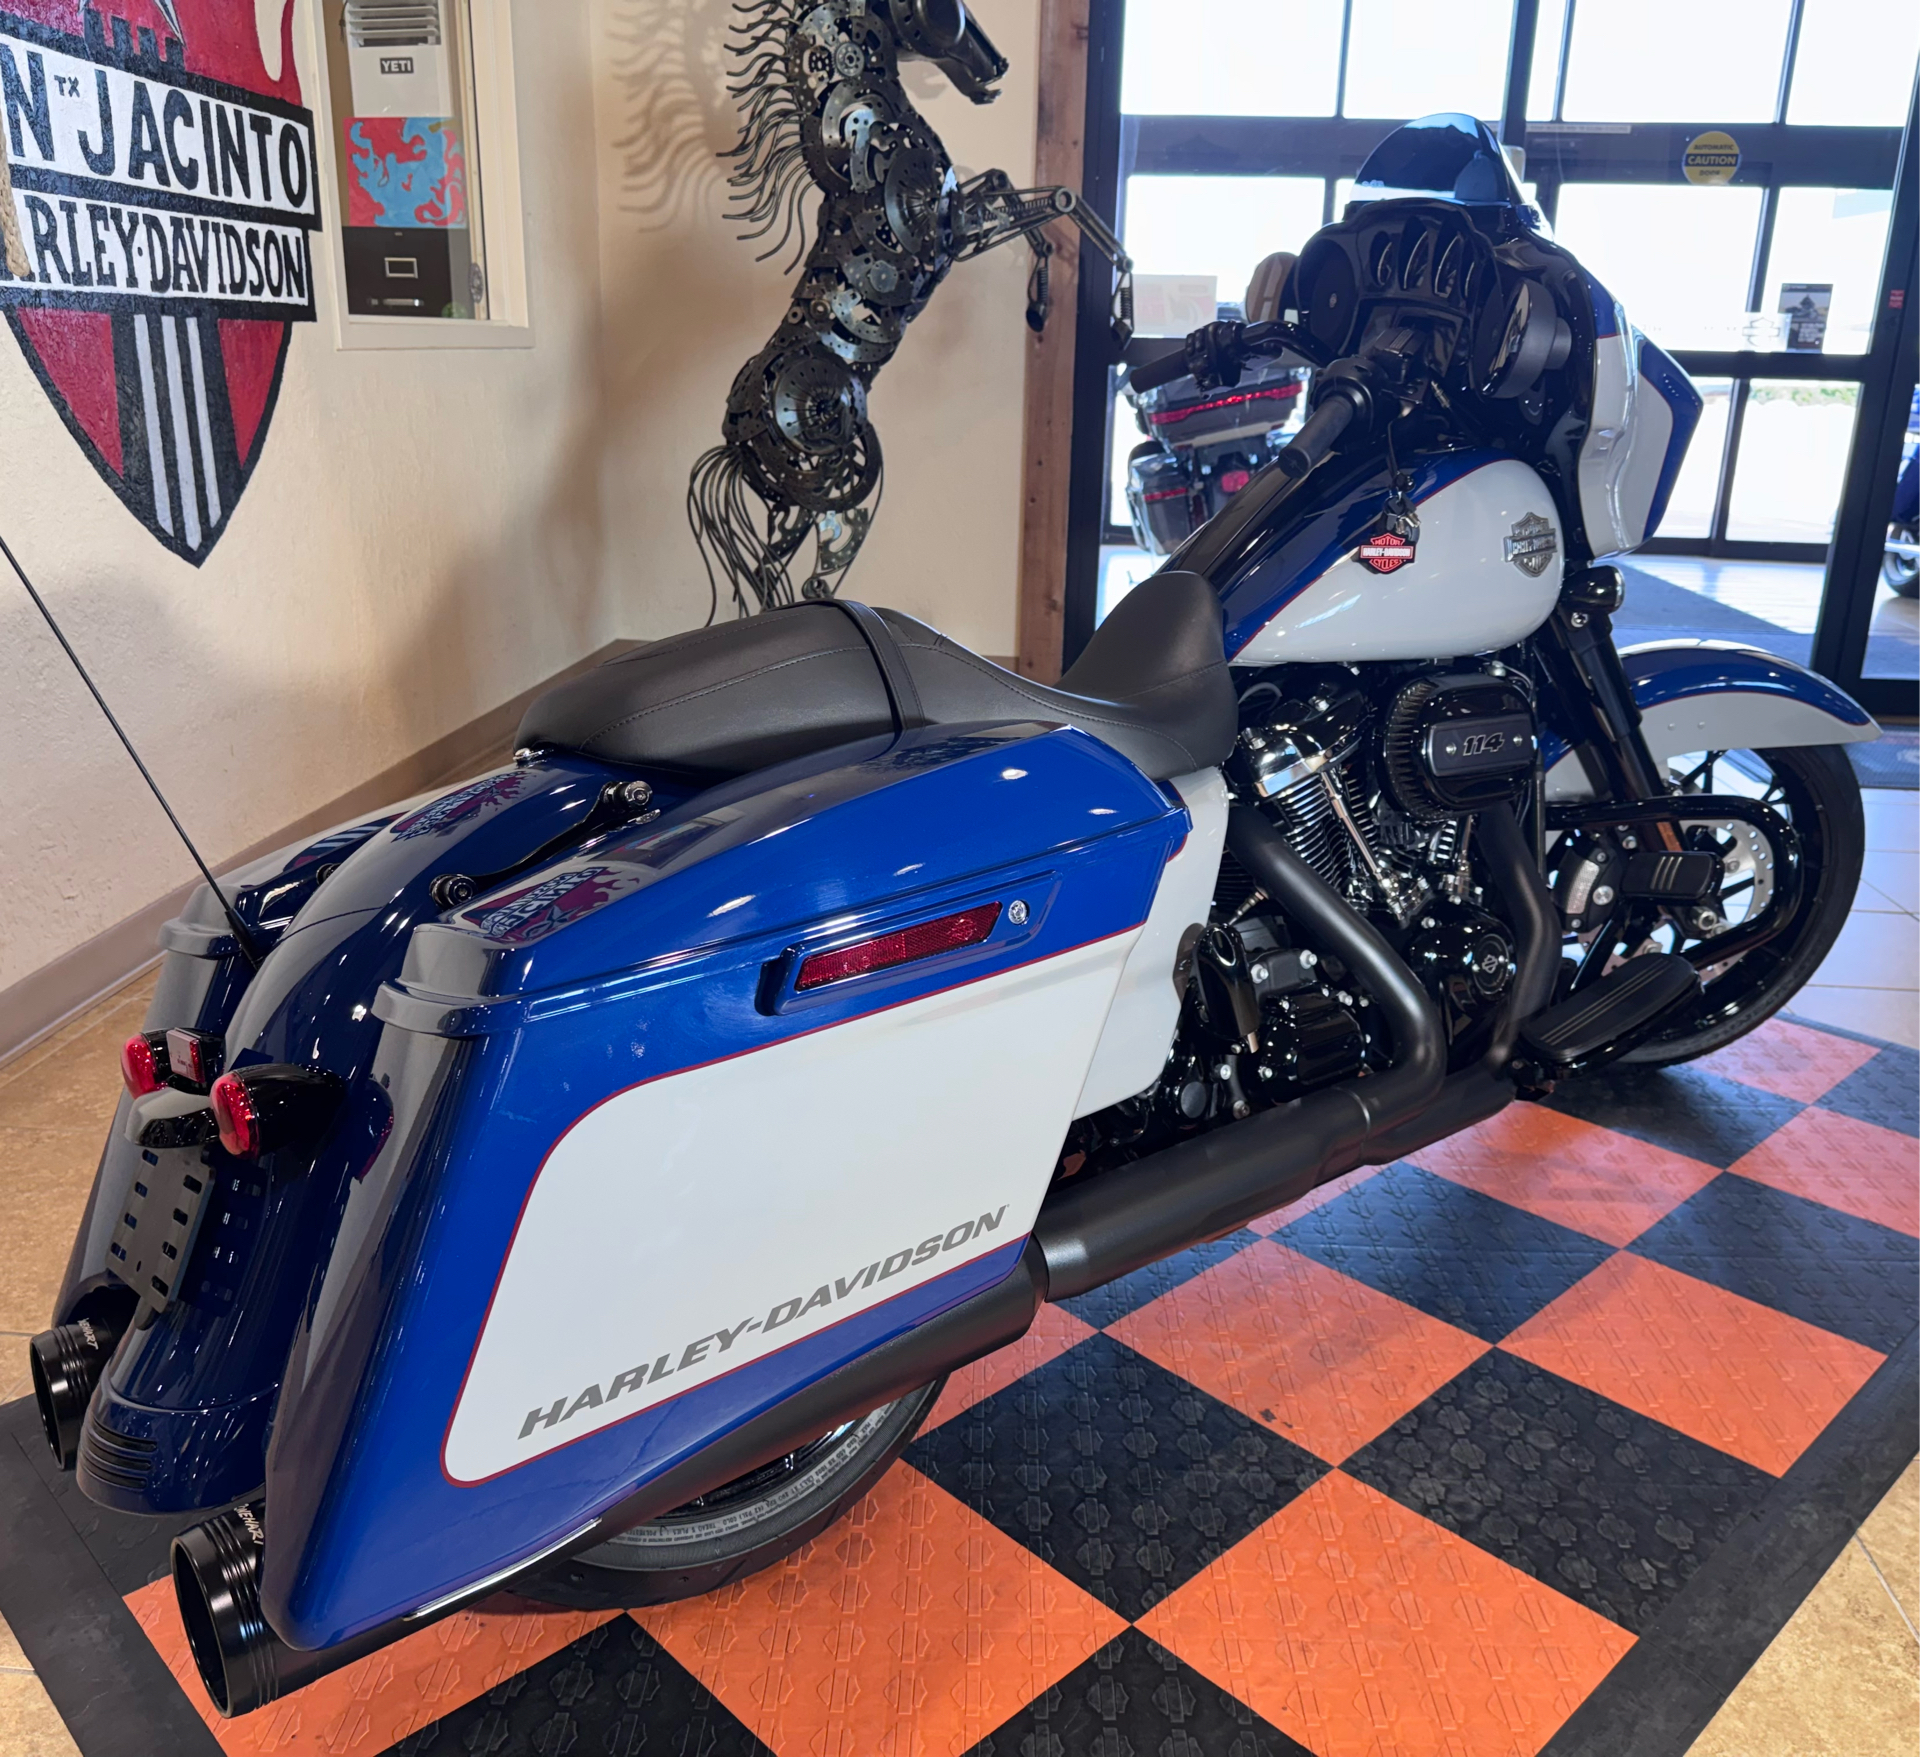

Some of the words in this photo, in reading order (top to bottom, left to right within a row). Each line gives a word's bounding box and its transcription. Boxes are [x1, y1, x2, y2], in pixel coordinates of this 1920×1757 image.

[381, 60, 412, 72] YETI
[77, 68, 308, 208] JACINTO
[1694, 143, 1735, 151] AUTOMATIC
[1687, 155, 1737, 165] CAUTION
[1374, 535, 1401, 546] MOTOR
[1362, 547, 1411, 557] HARLEY-DAVIDSON
[1373, 558, 1399, 570] CYCLES
[1462, 732, 1505, 756] 114
[517, 1204, 1008, 1441] HARLEY-DAVIDSON
